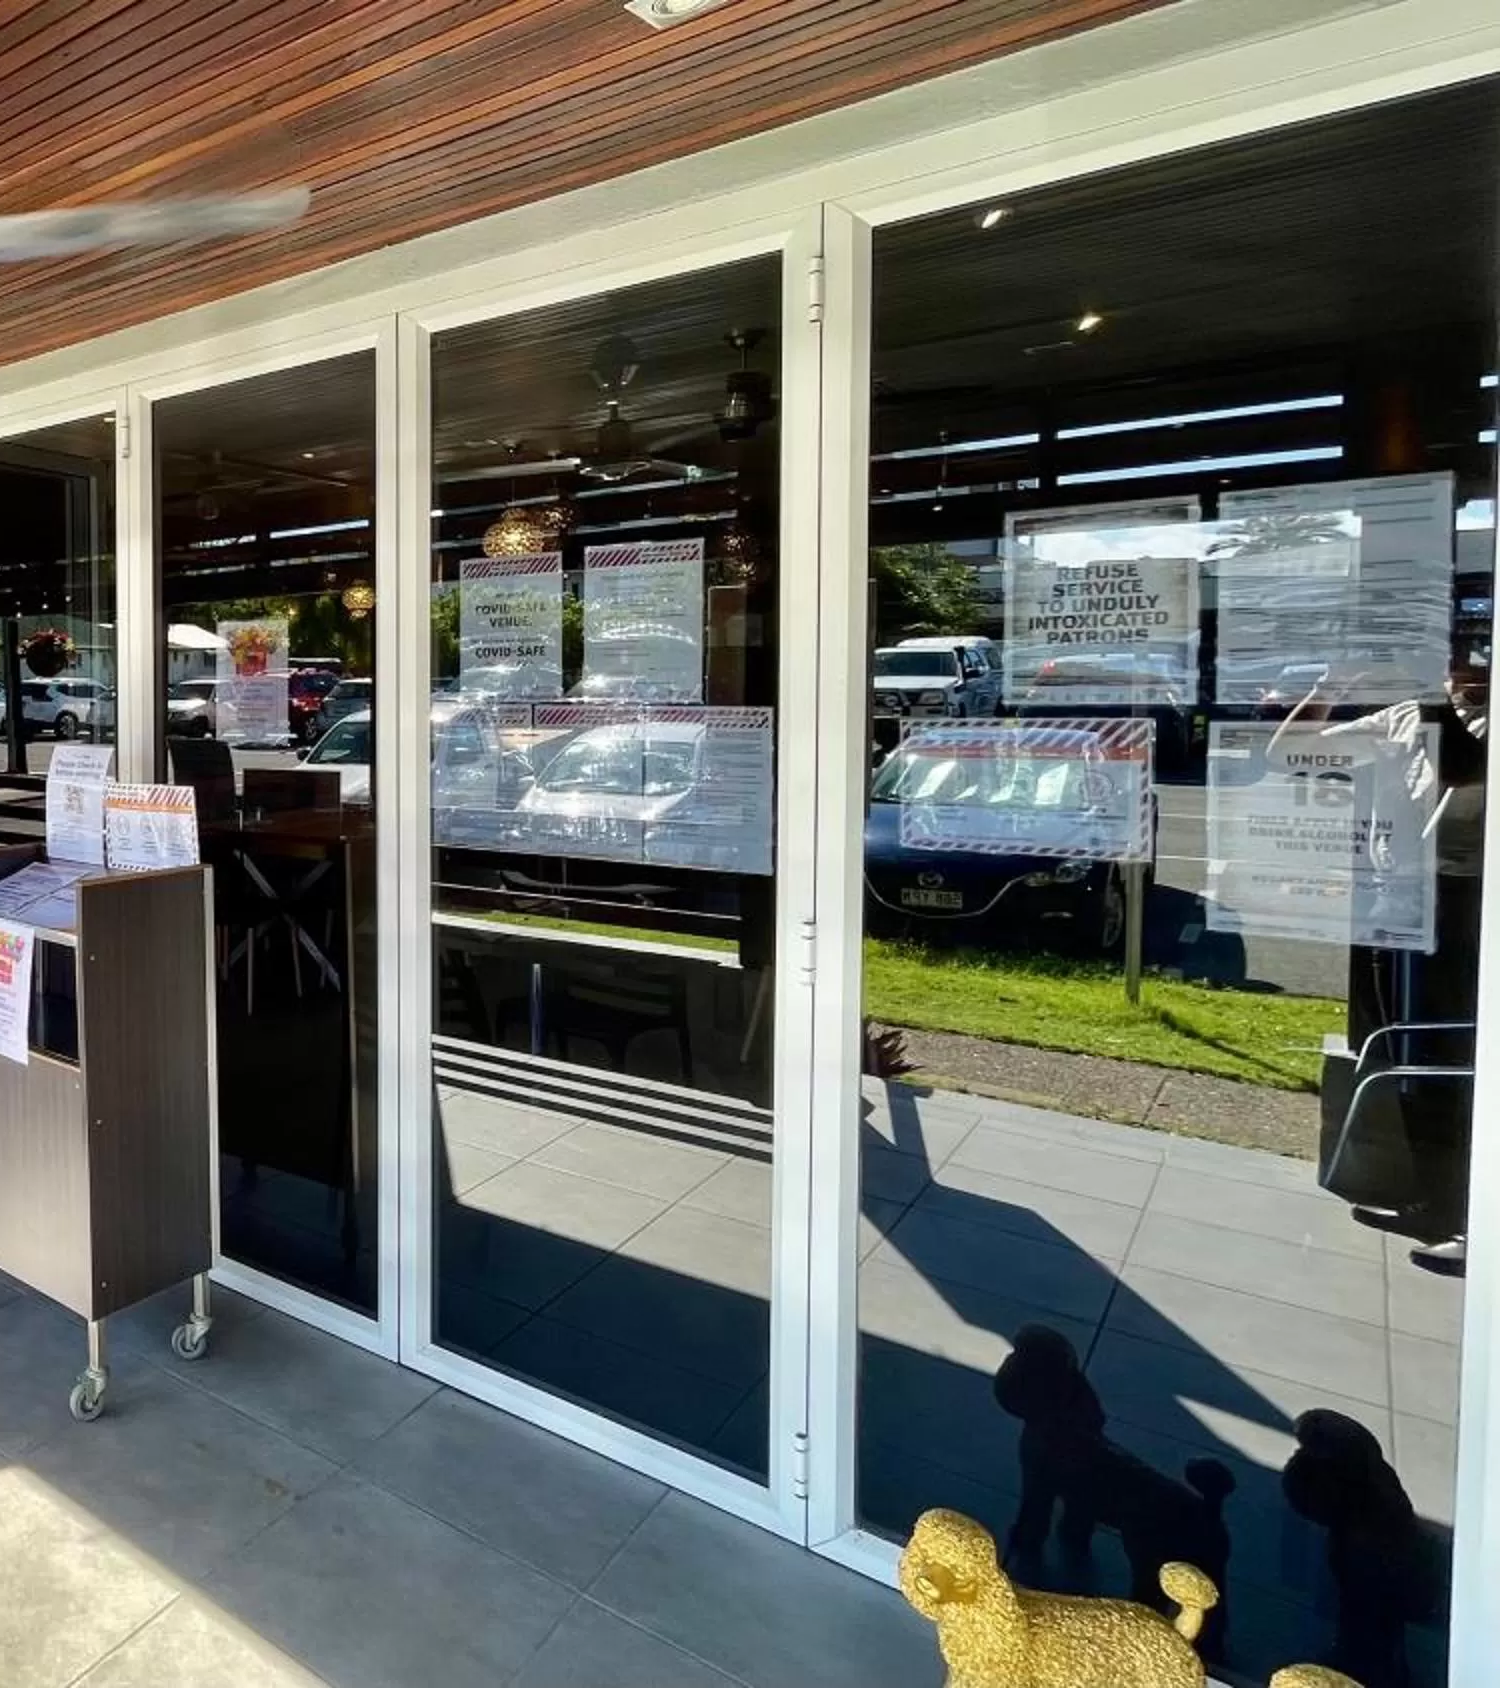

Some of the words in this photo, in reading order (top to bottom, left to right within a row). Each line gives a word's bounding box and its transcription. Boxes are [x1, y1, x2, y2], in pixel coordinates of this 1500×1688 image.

[1057, 563, 1139, 582] REFUSE
[1052, 578, 1144, 598] SERVICE
[1037, 600, 1065, 614] TO
[1072, 594, 1160, 613] UNDULY
[1028, 610, 1169, 631] INTOXICATED
[1046, 627, 1149, 645] PATRONS
[475, 645, 546, 659] COVID-SAFE
[1286, 754, 1353, 767] UNDER
[1285, 770, 1353, 808] 18
